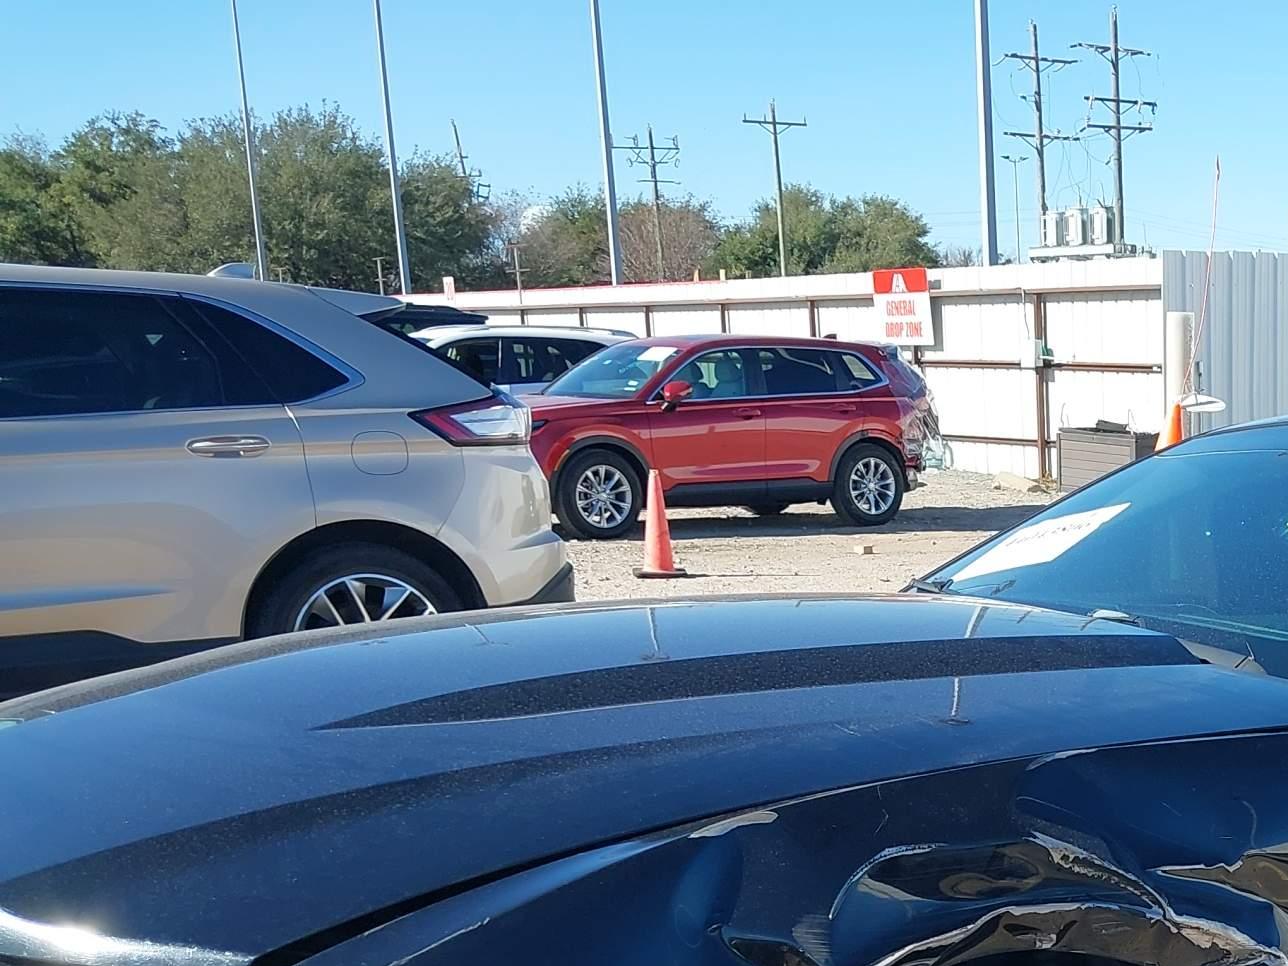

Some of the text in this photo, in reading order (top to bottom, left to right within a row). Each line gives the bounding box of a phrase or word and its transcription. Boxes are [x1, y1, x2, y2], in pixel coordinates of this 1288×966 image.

[886, 299, 916, 317] GENERAL
[885, 320, 924, 338] DROP ZONE
